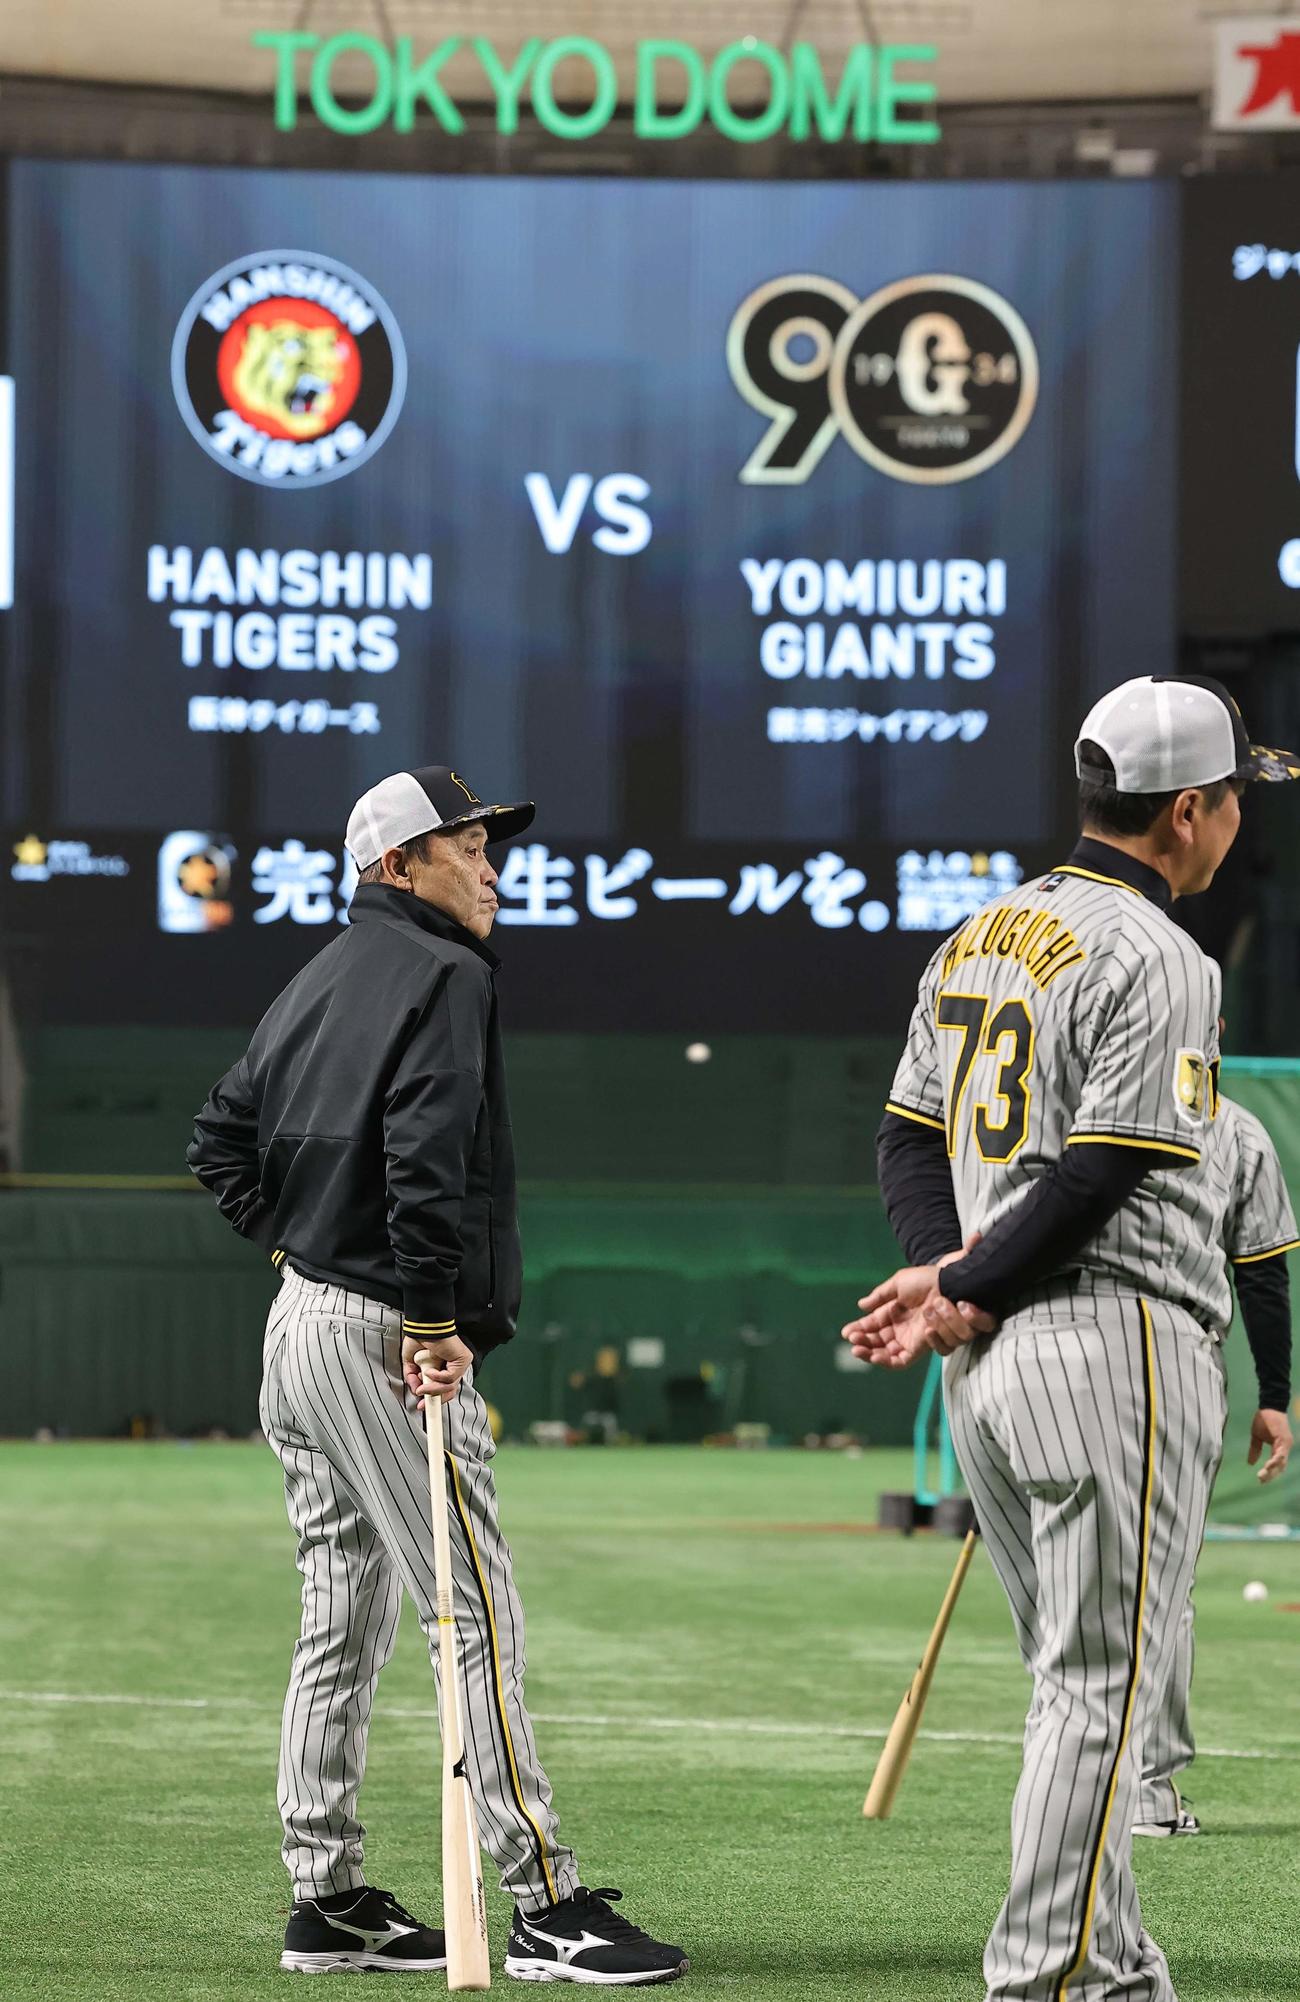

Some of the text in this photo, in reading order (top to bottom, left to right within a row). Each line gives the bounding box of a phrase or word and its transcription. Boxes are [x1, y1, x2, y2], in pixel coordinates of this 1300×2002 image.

[253, 31, 941, 144] TOKYO DOME
[201, 264, 376, 334] HANSHIN
[209, 410, 367, 479] Tigers
[525, 473, 651, 555] VS
[147, 545, 432, 610] HANSHIN
[741, 557, 1006, 615] YOMIURI
[170, 610, 399, 672] TIGERS
[760, 622, 996, 679] GIANTS
[935, 991, 1034, 1163] 73
